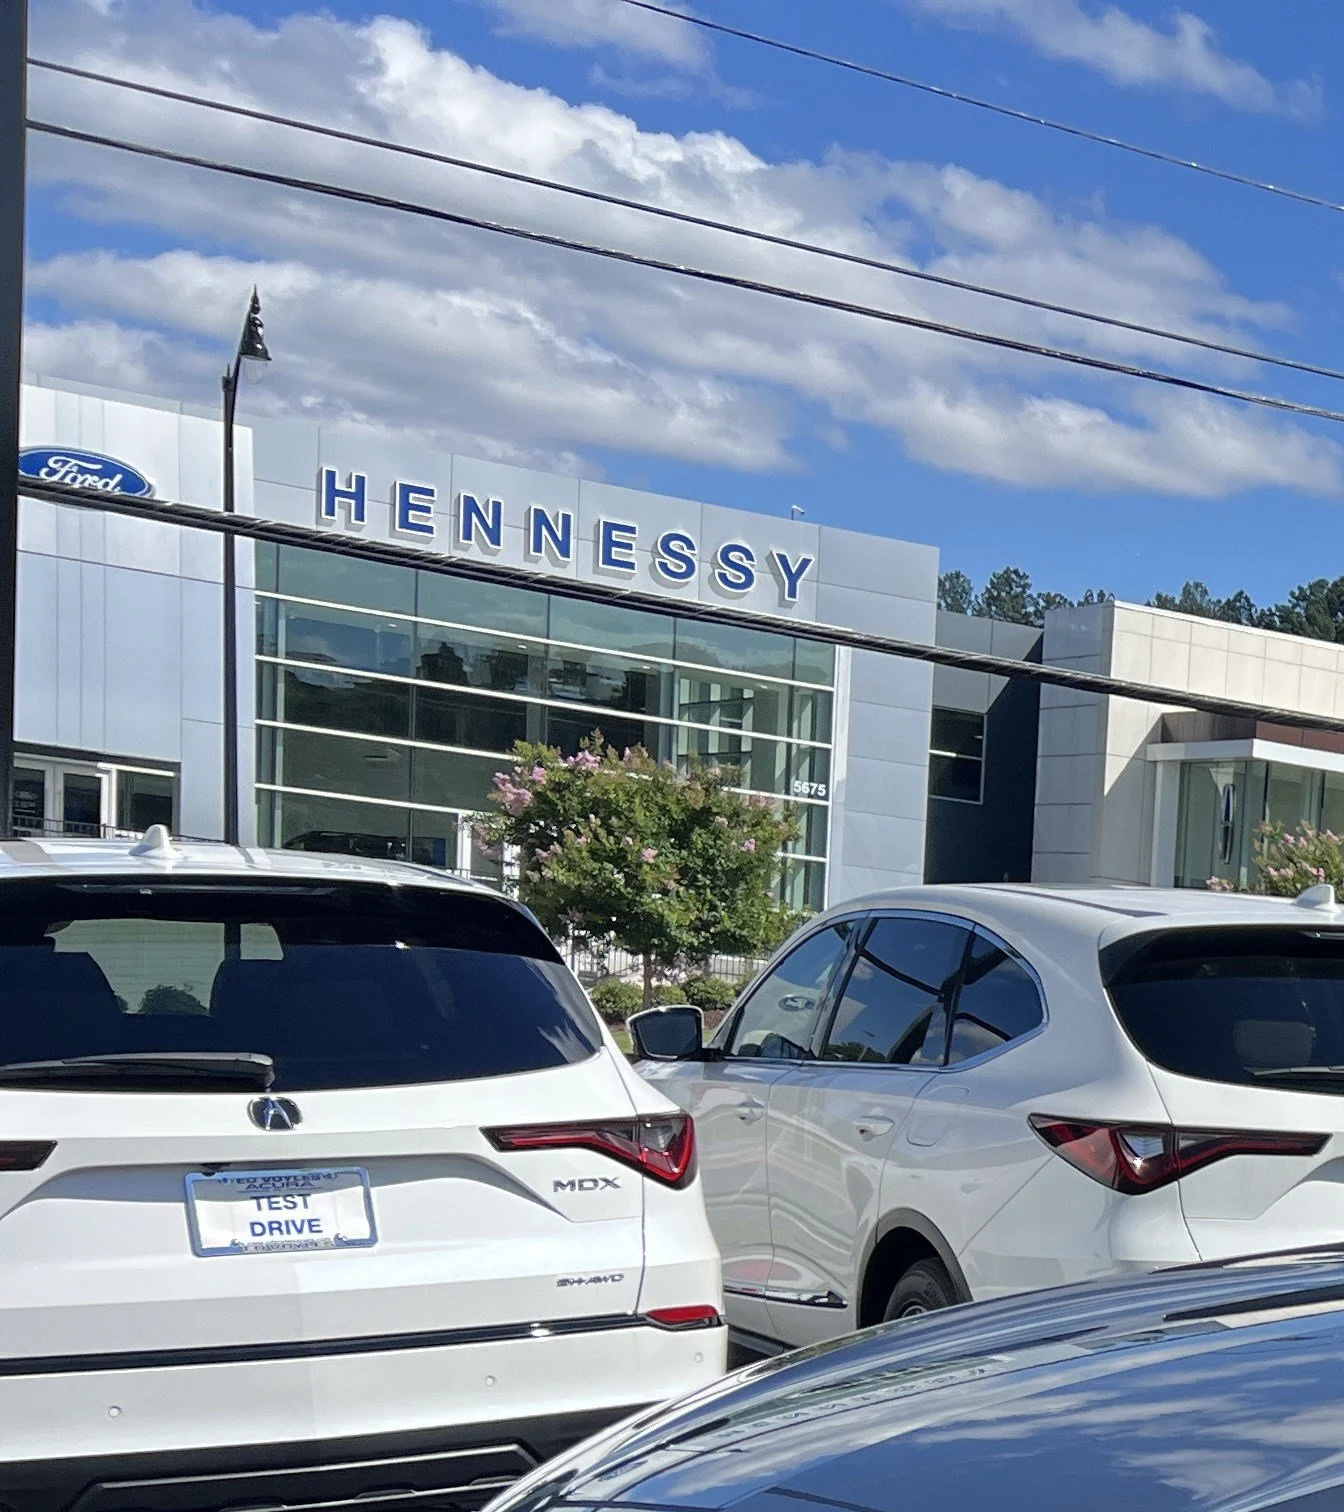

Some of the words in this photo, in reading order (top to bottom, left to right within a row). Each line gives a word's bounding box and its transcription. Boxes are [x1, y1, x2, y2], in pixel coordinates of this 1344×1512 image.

[39, 456, 123, 492] Ford
[319, 466, 816, 602] HENNESSY
[793, 780, 827, 797] 5675
[552, 1176, 621, 1193] MDX
[250, 1193, 311, 1212] TEST
[249, 1218, 324, 1238] DRIVE
